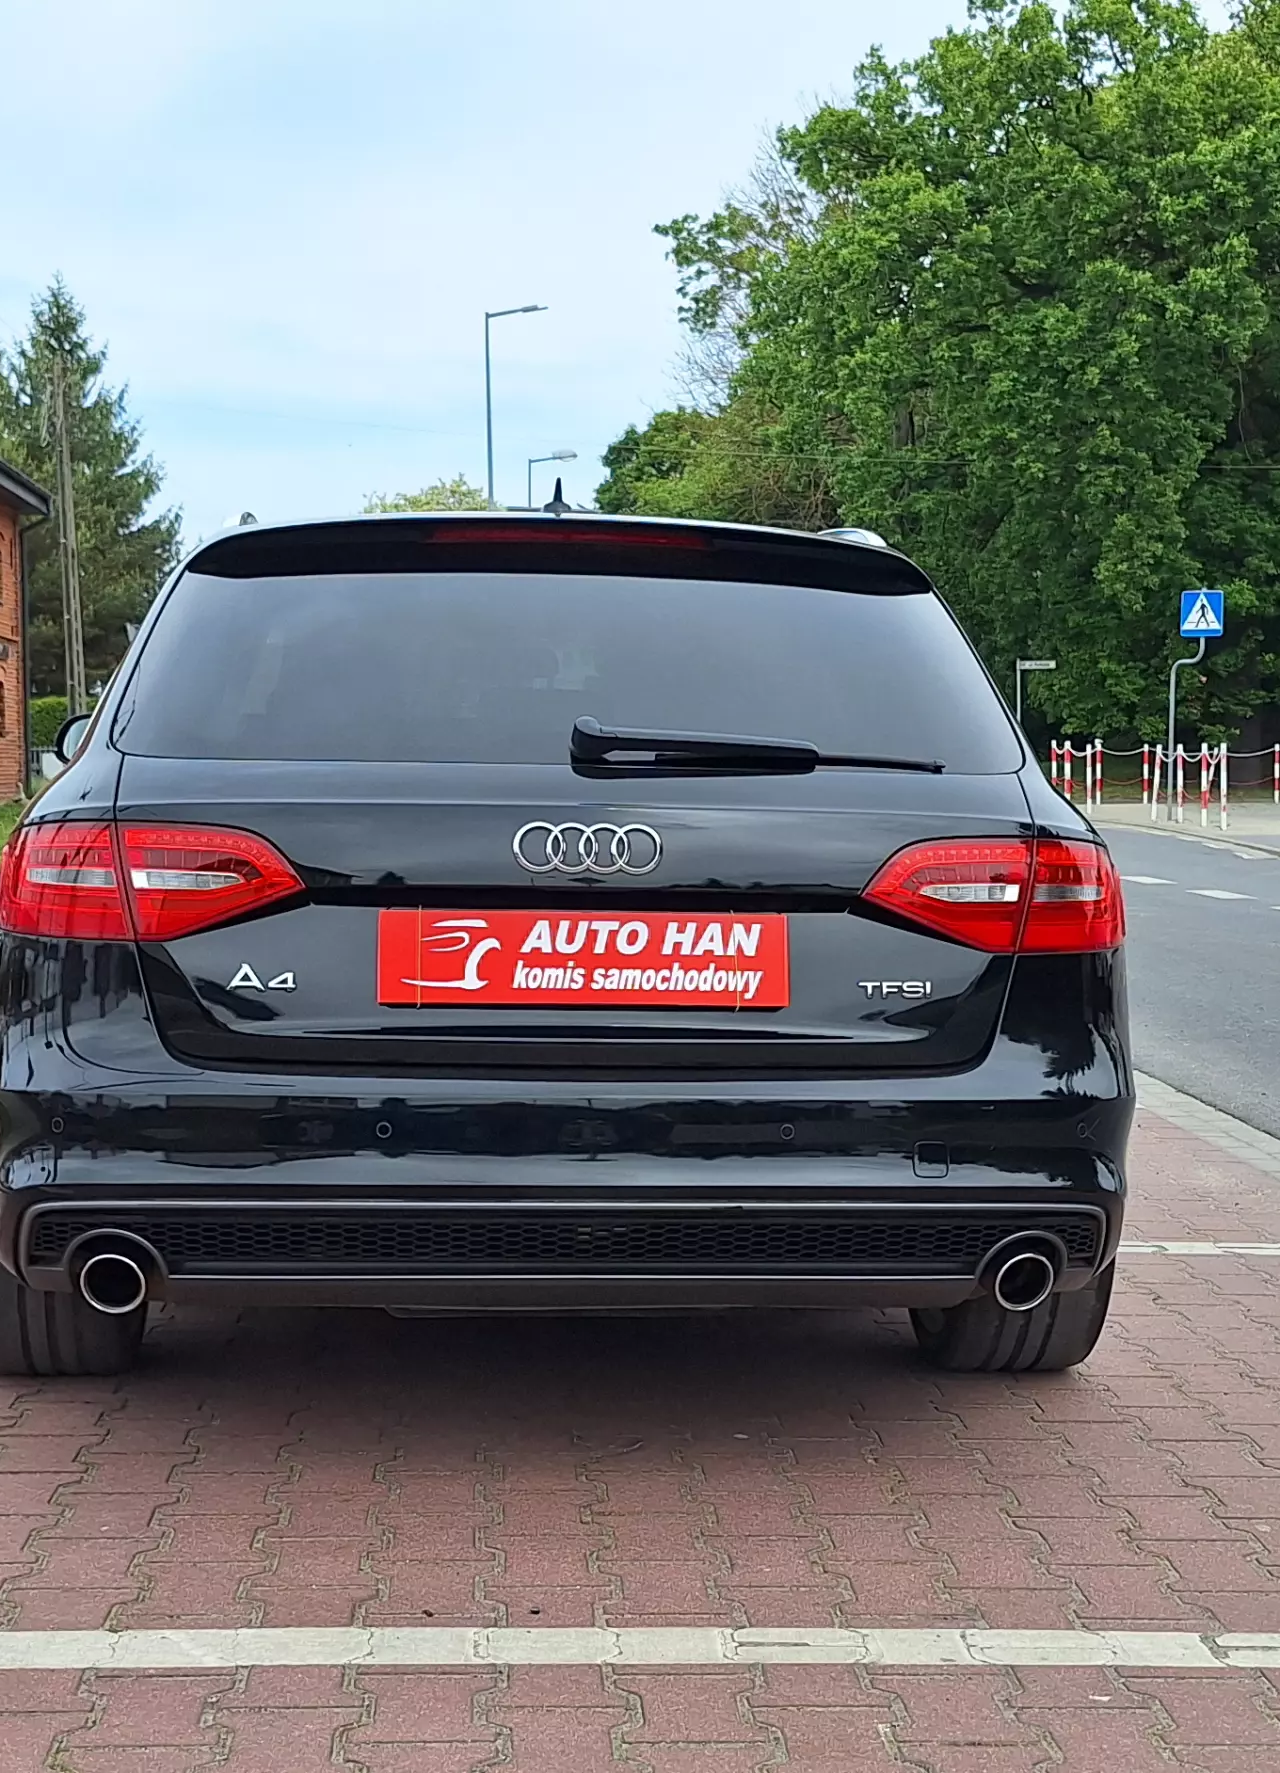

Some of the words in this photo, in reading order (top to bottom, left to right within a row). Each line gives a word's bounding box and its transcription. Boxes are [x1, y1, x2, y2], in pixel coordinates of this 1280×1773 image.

[519, 918, 649, 956] AUTO
[662, 921, 762, 957] HAN
[225, 963, 297, 992] A4
[512, 960, 584, 991] komis
[591, 963, 763, 1000] samochodowy
[858, 981, 932, 999] TFSI
